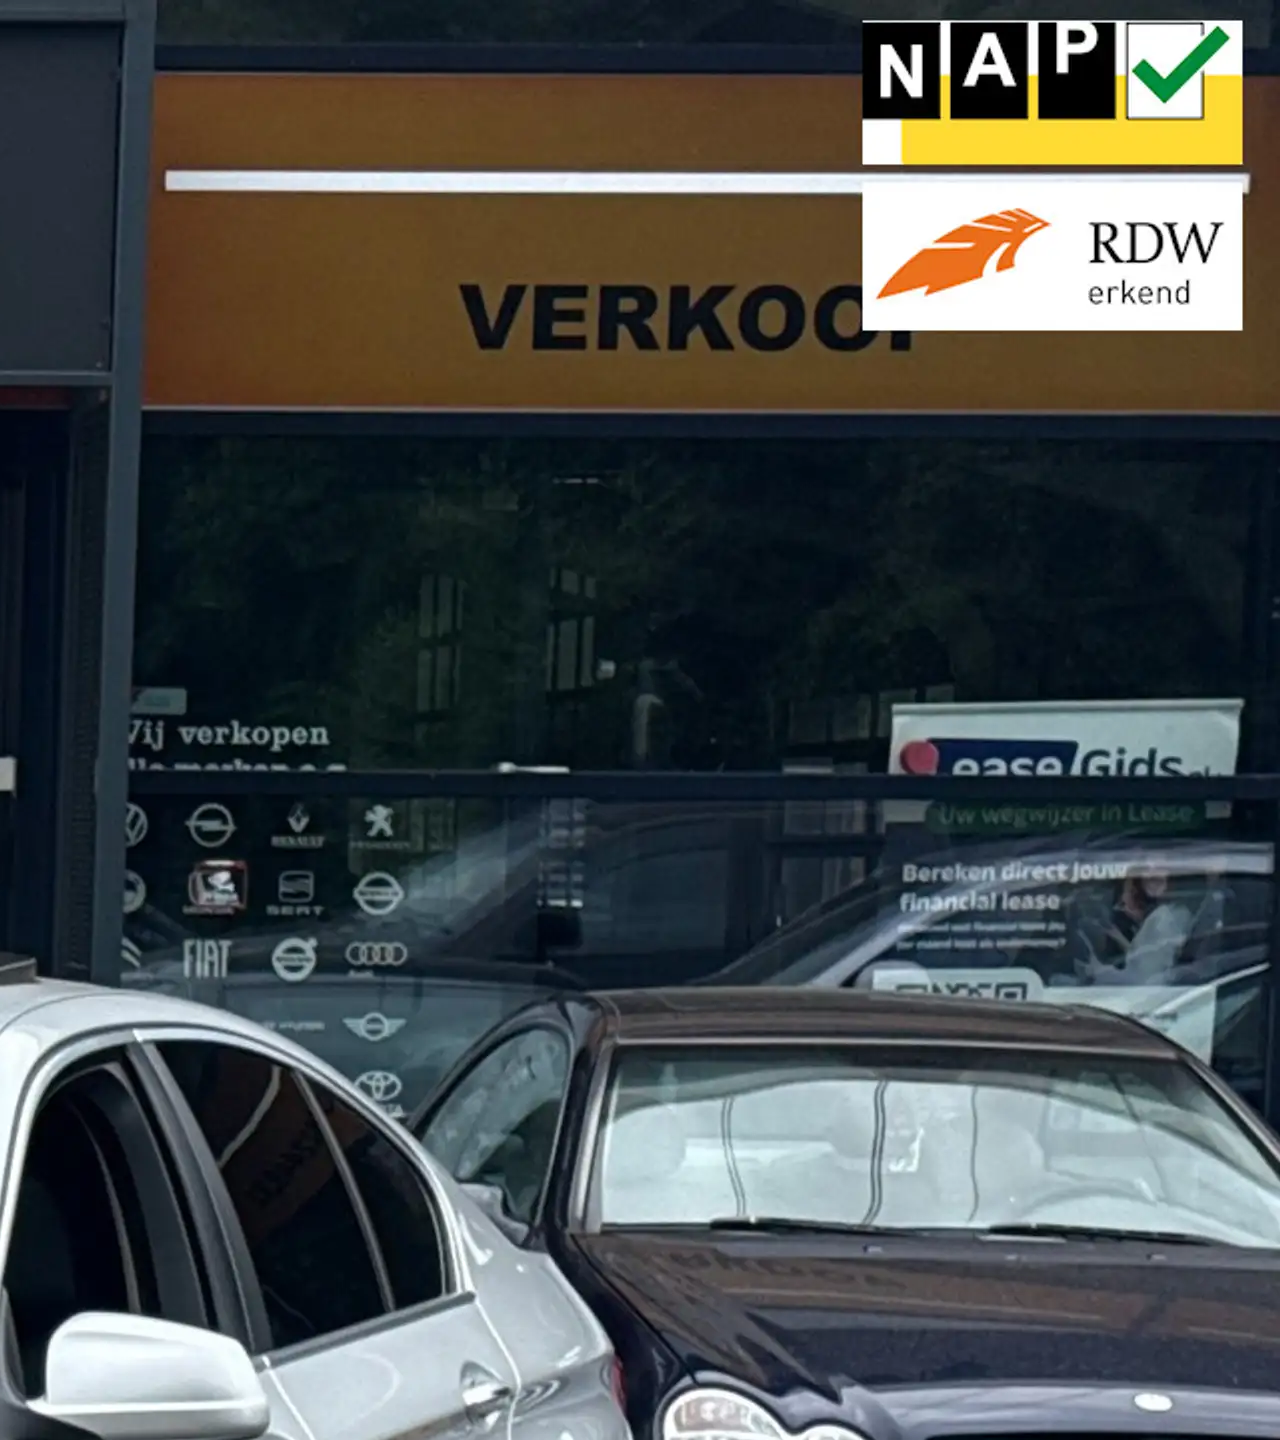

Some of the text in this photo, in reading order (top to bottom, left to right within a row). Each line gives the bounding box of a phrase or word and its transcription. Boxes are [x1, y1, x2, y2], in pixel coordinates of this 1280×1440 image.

[178, 719, 330, 752] verkopen
[981, 804, 1092, 828] wegwijzer
[1128, 802, 1196, 822] Lease
[902, 863, 996, 882] Bereken
[1001, 861, 1068, 882] direct
[899, 890, 1061, 913] financial lease
[183, 939, 233, 979] FIAT
